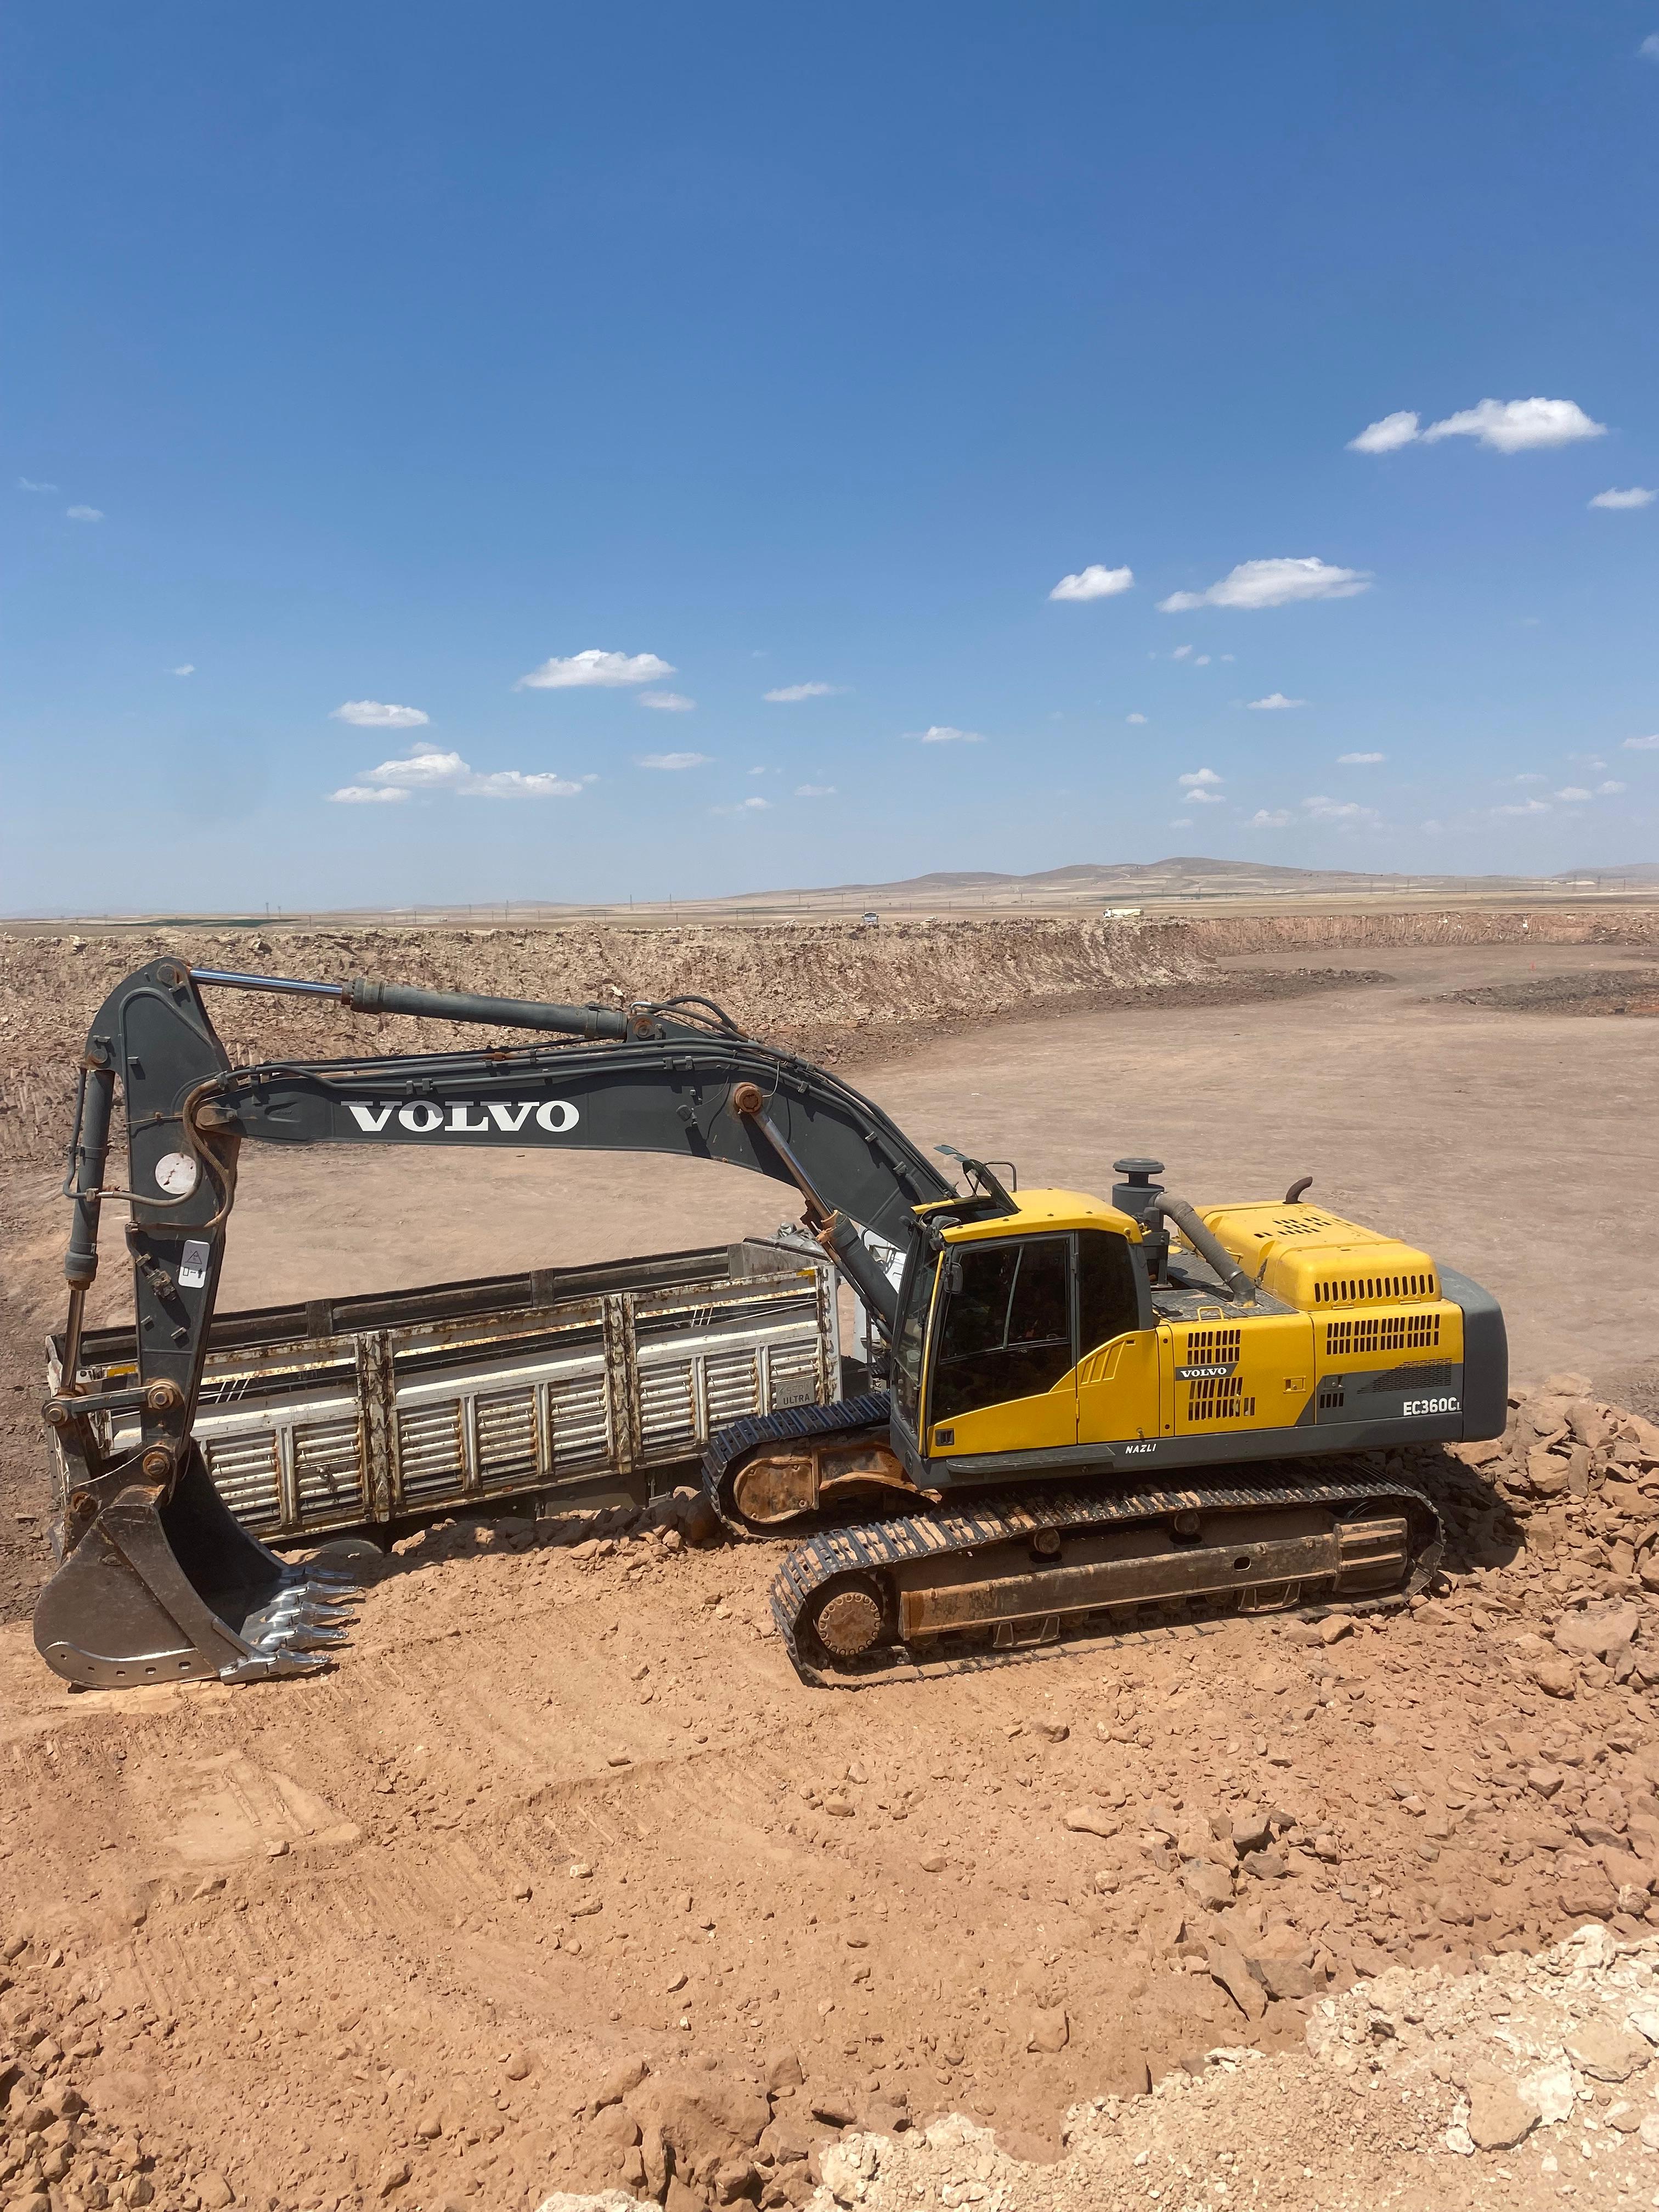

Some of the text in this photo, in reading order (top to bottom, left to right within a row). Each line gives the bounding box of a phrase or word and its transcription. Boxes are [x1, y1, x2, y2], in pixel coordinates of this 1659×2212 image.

[341, 1100, 579, 1132] VOLVO
[1181, 1367, 1227, 1378] VOLVO
[783, 1393, 810, 1405] ULTRA
[1125, 1443, 1156, 1454] NAZLI
